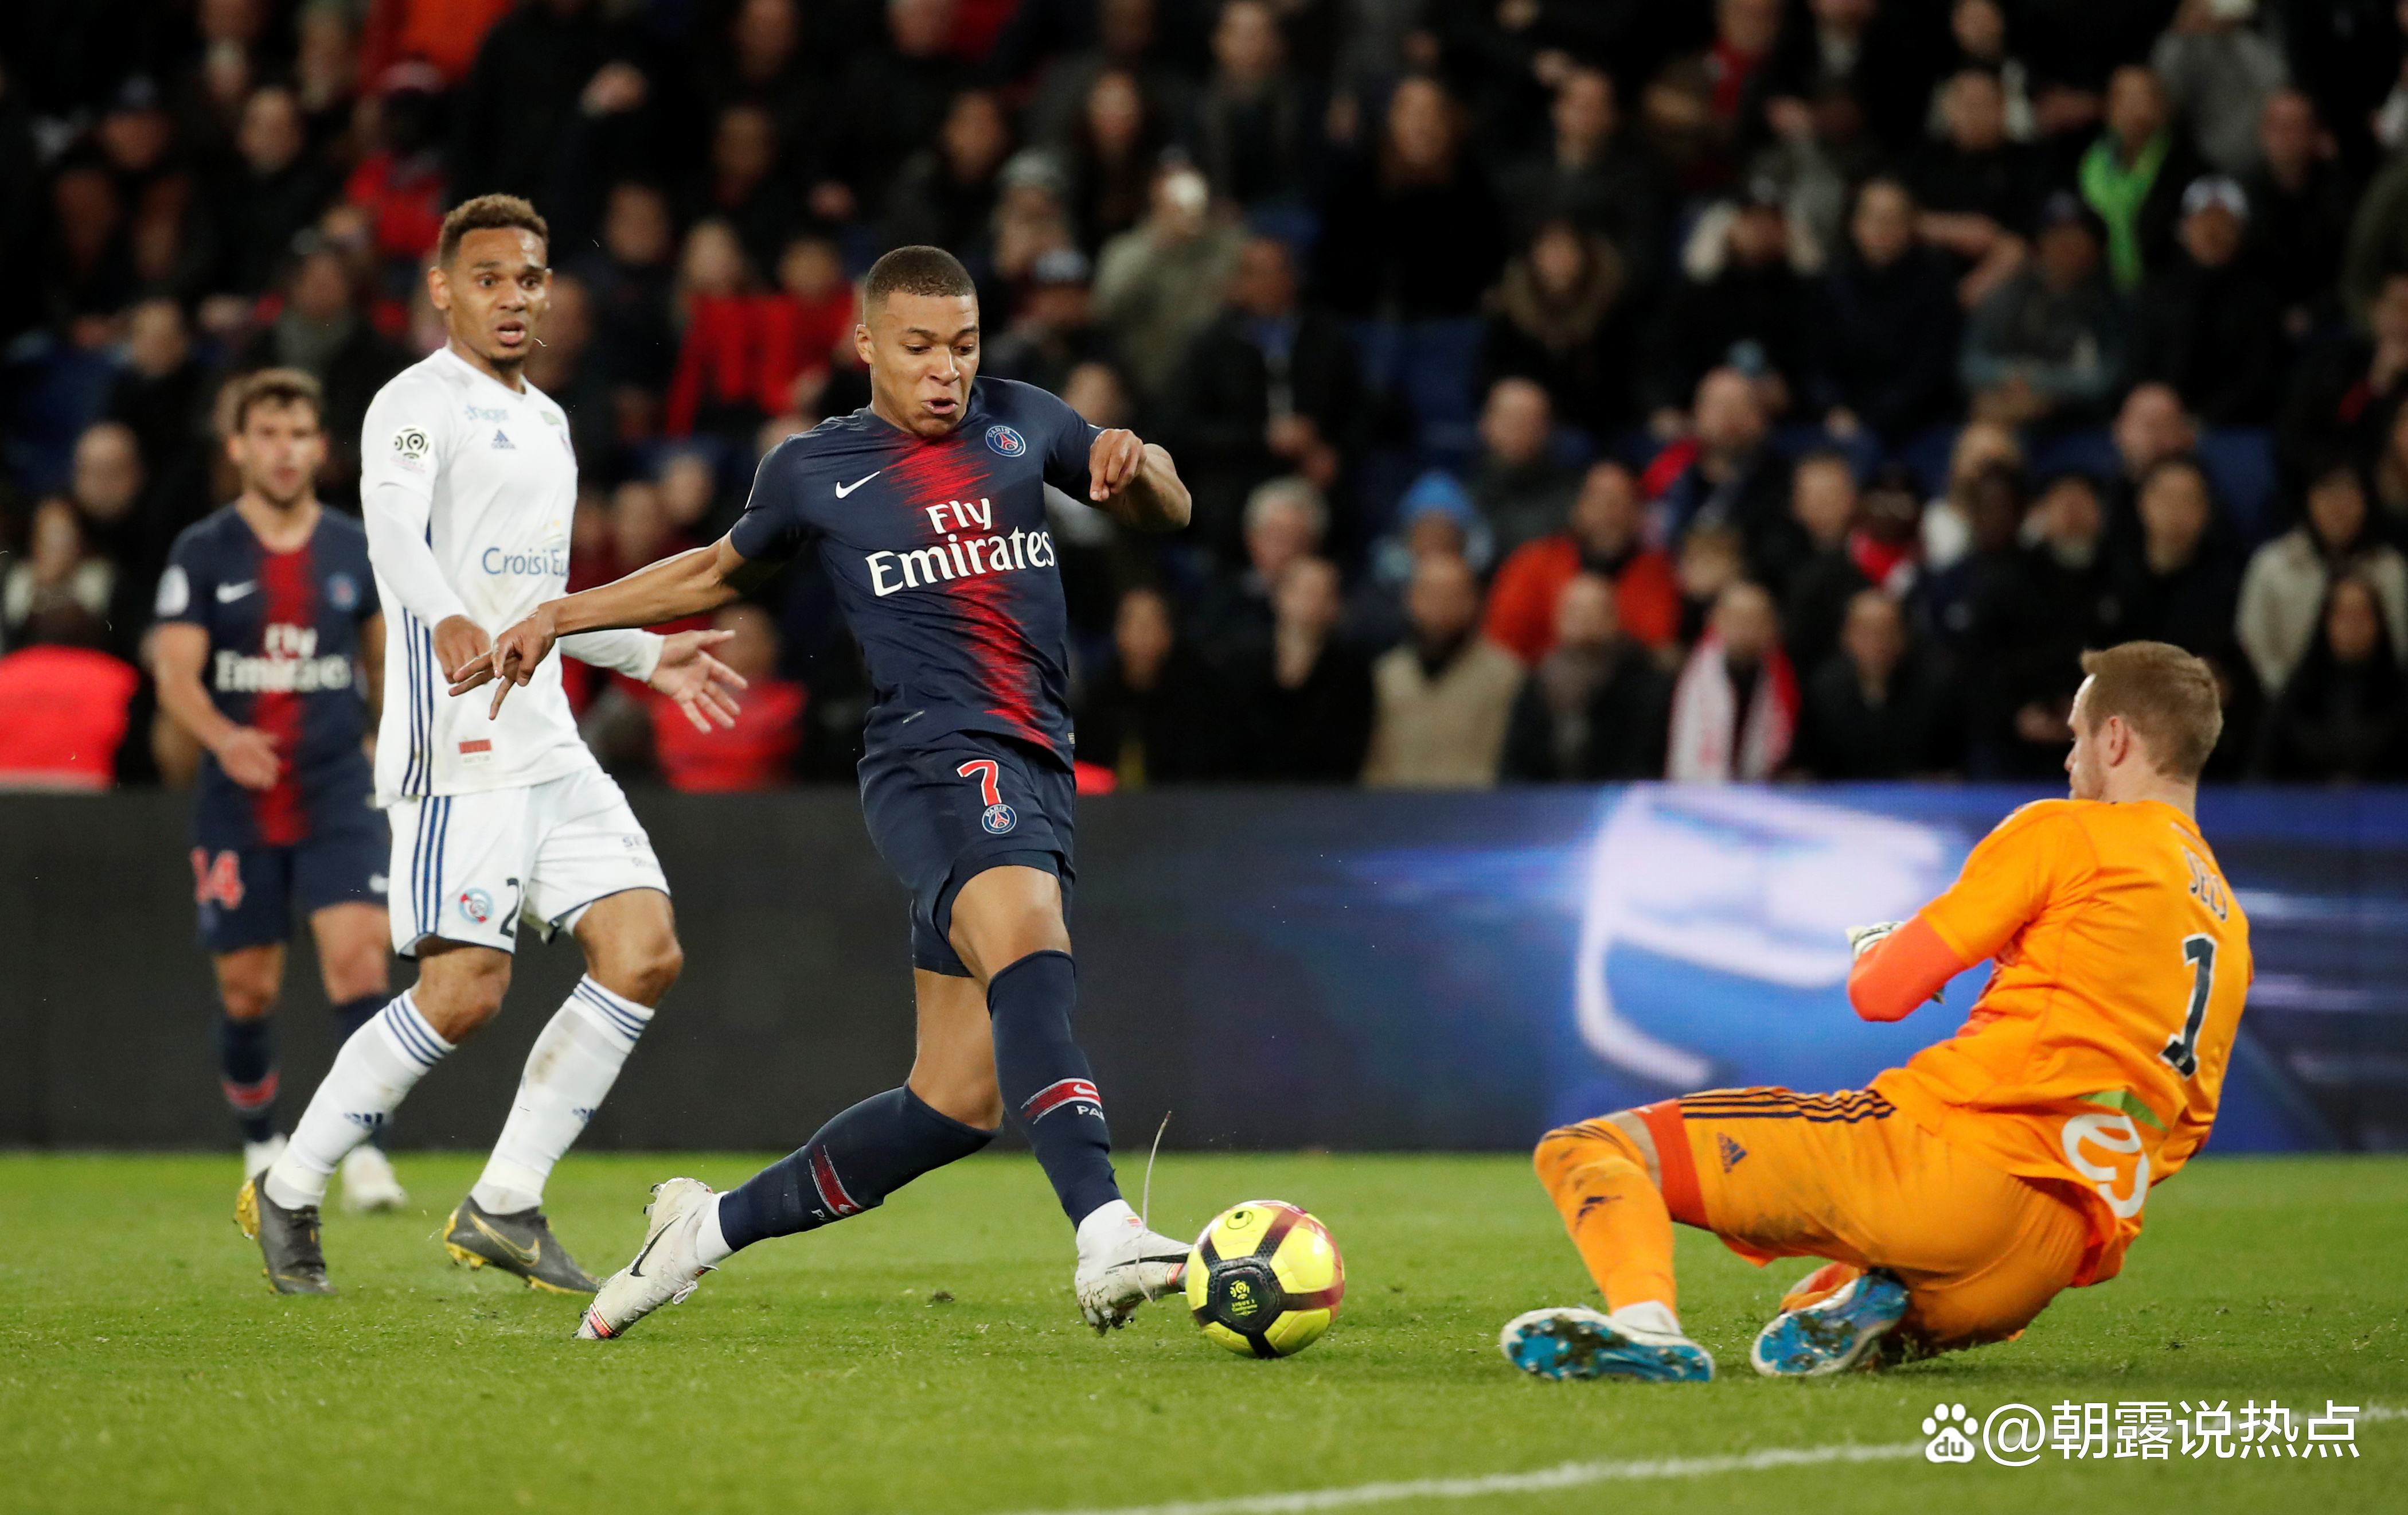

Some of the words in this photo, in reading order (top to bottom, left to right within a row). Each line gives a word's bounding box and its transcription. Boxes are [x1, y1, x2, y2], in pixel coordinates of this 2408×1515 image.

[988, 427, 1010, 438] PARIS
[925, 497, 992, 535] Fly
[865, 525, 1056, 597] Emirates
[957, 759, 1002, 807] 7
[985, 806, 1007, 817] PARIS
[190, 846, 245, 909] 14
[499, 877, 525, 938] 2
[2158, 932, 2217, 1081] 1
